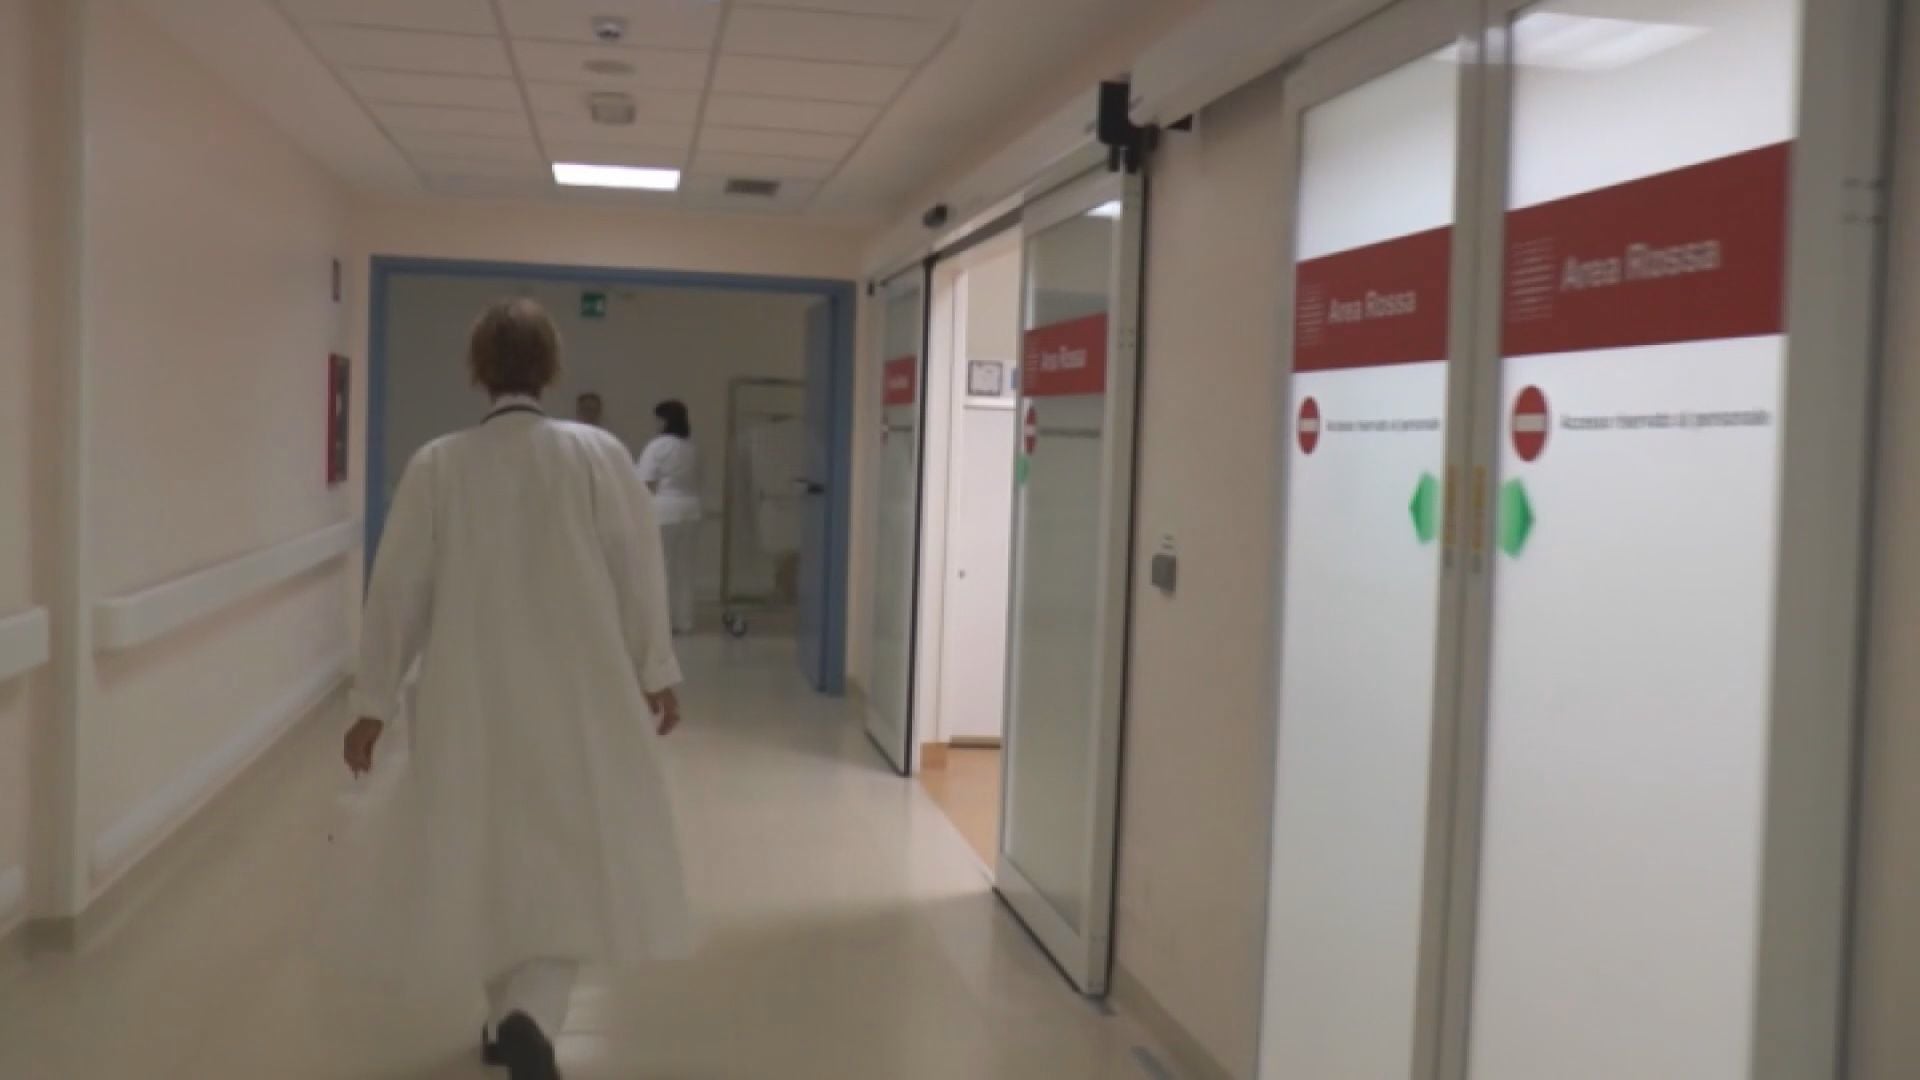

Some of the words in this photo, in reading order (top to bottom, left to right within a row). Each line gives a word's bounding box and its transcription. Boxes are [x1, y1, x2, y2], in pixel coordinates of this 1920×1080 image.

[1560, 255, 1621, 292] Area
[1625, 240, 1722, 280] Rossa
[1328, 297, 1362, 327] Area
[1364, 289, 1417, 319] Rossa
